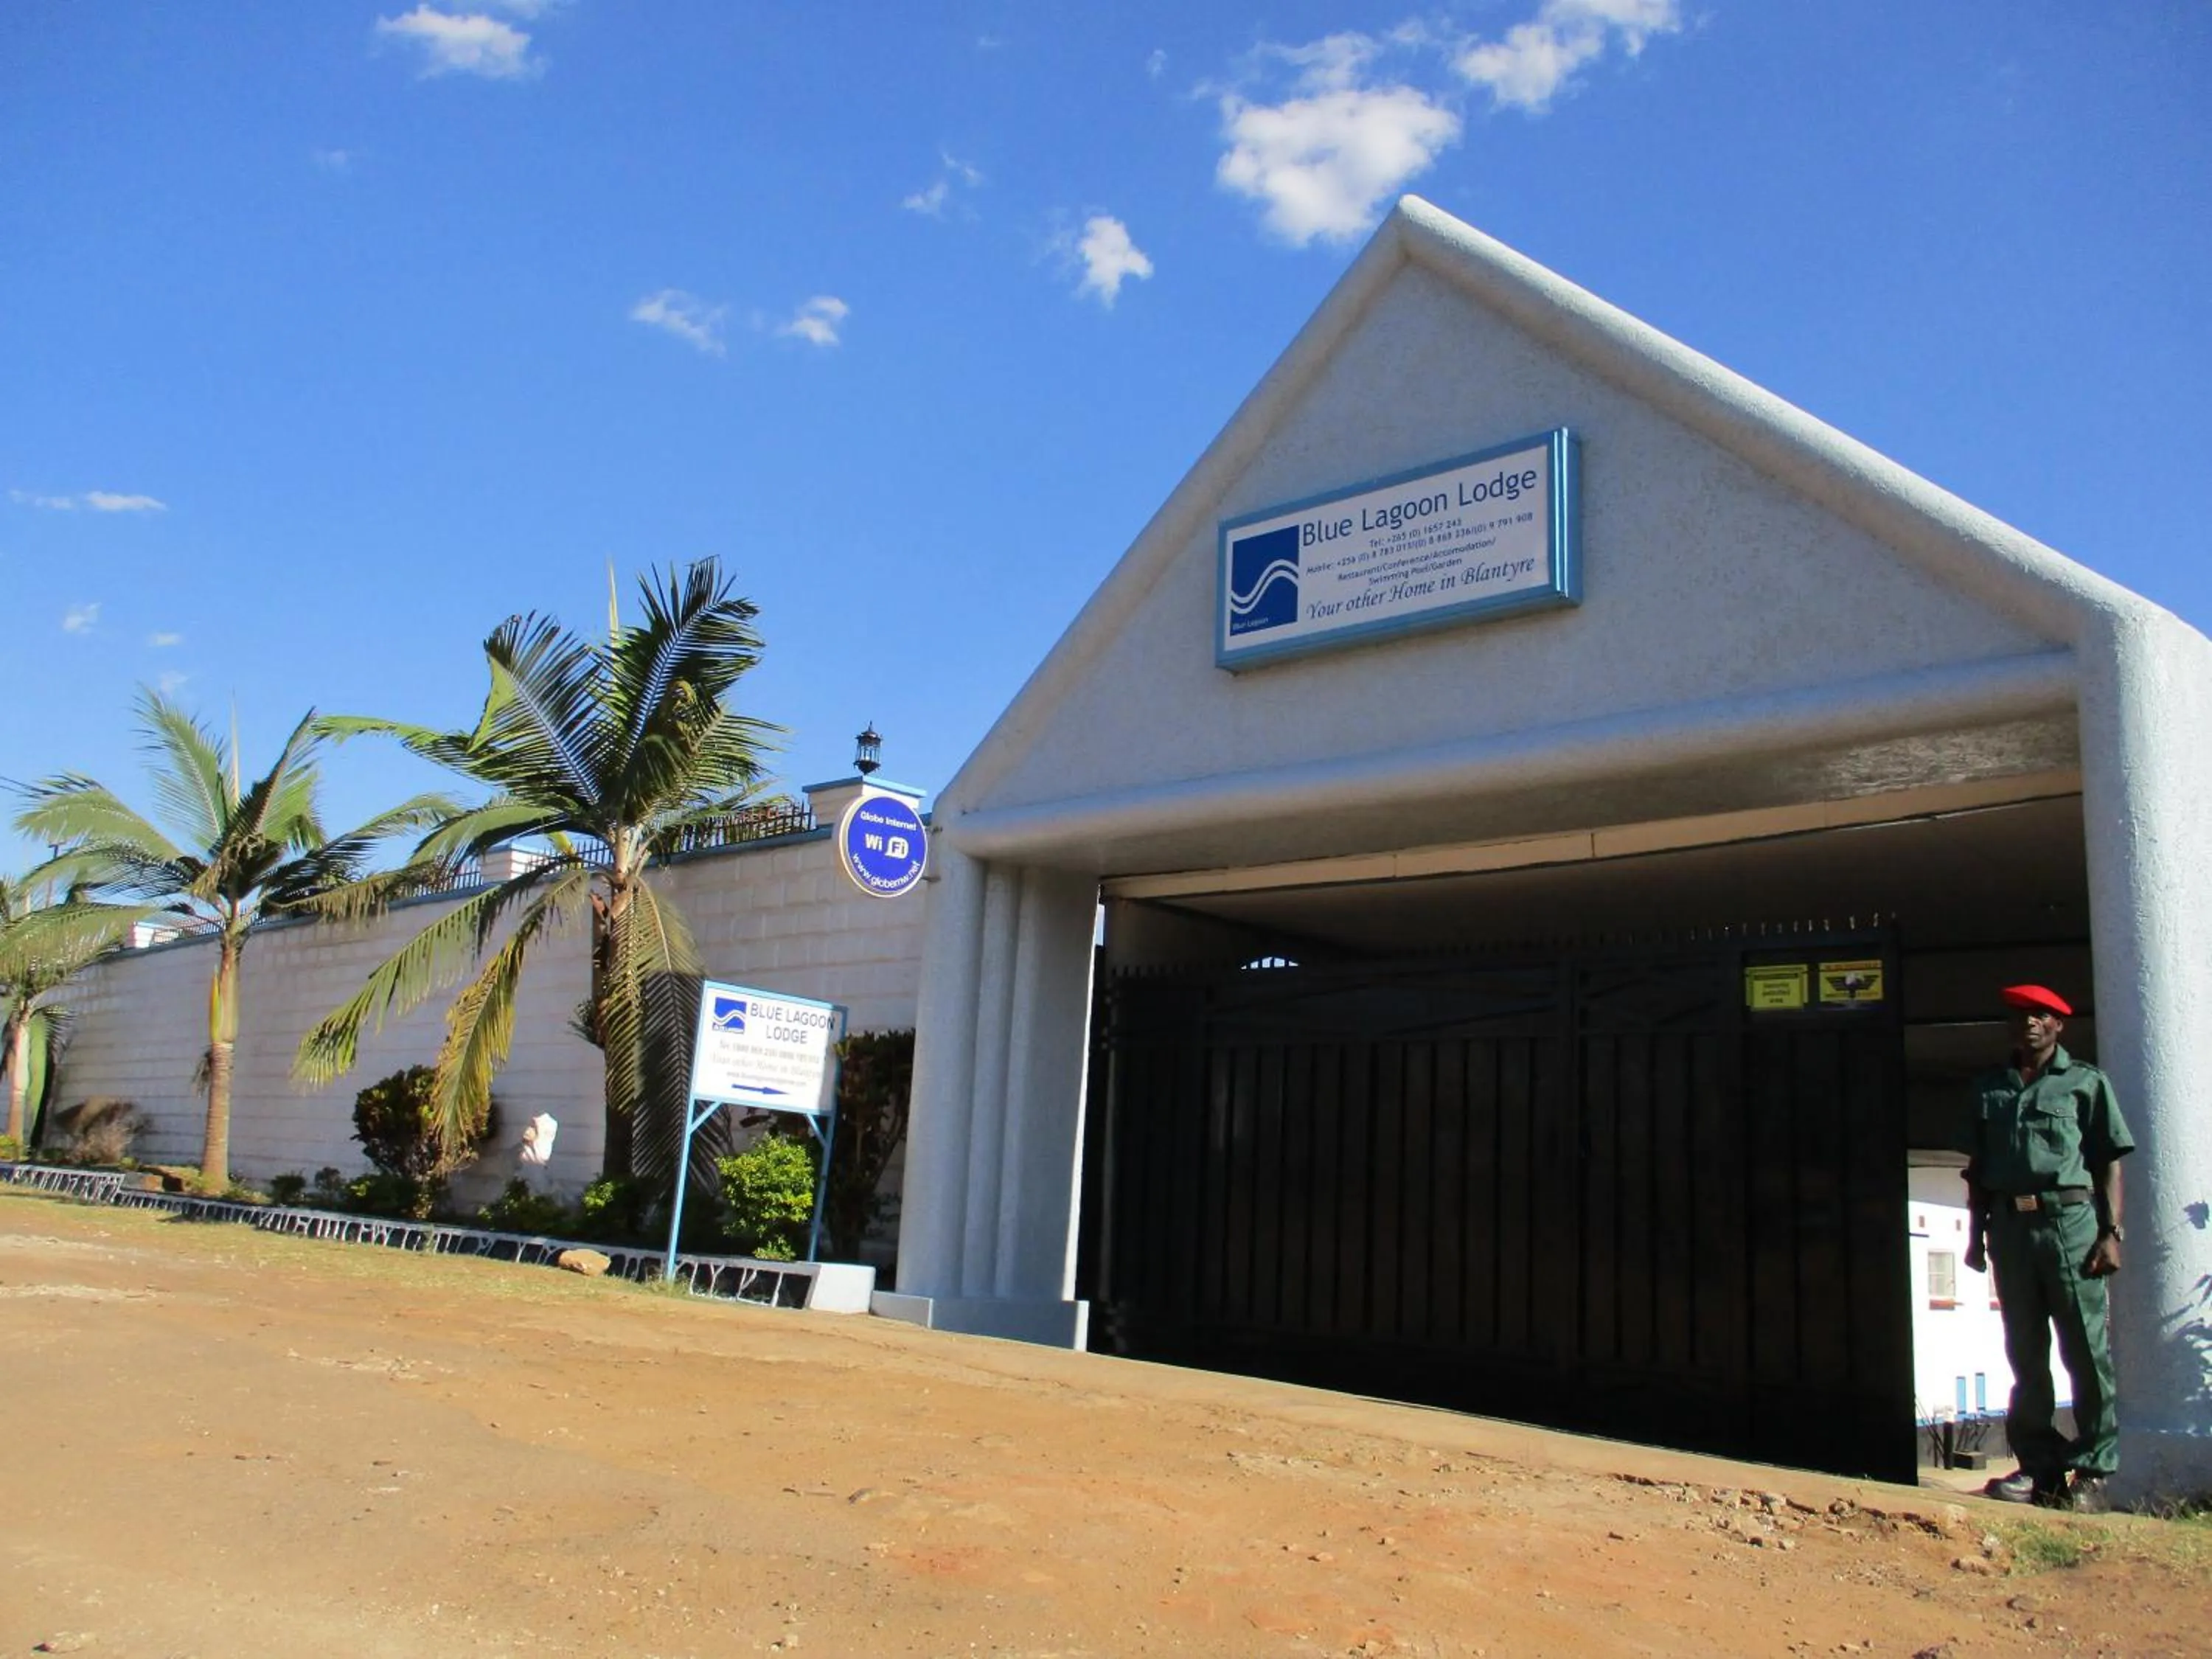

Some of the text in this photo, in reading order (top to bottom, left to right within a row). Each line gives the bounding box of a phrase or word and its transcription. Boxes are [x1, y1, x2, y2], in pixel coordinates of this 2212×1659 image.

[1302, 469, 1537, 546] Blue Lagoon Lodge
[1369, 538, 1385, 548] Tel:
[1306, 558, 1535, 619] Your other Home in Blantyre
[860, 811, 917, 831] Globe Internet
[865, 833, 883, 852] Wi
[750, 1002, 835, 1030] BLUE LAGOON
[766, 1025, 807, 1044] LODGE
